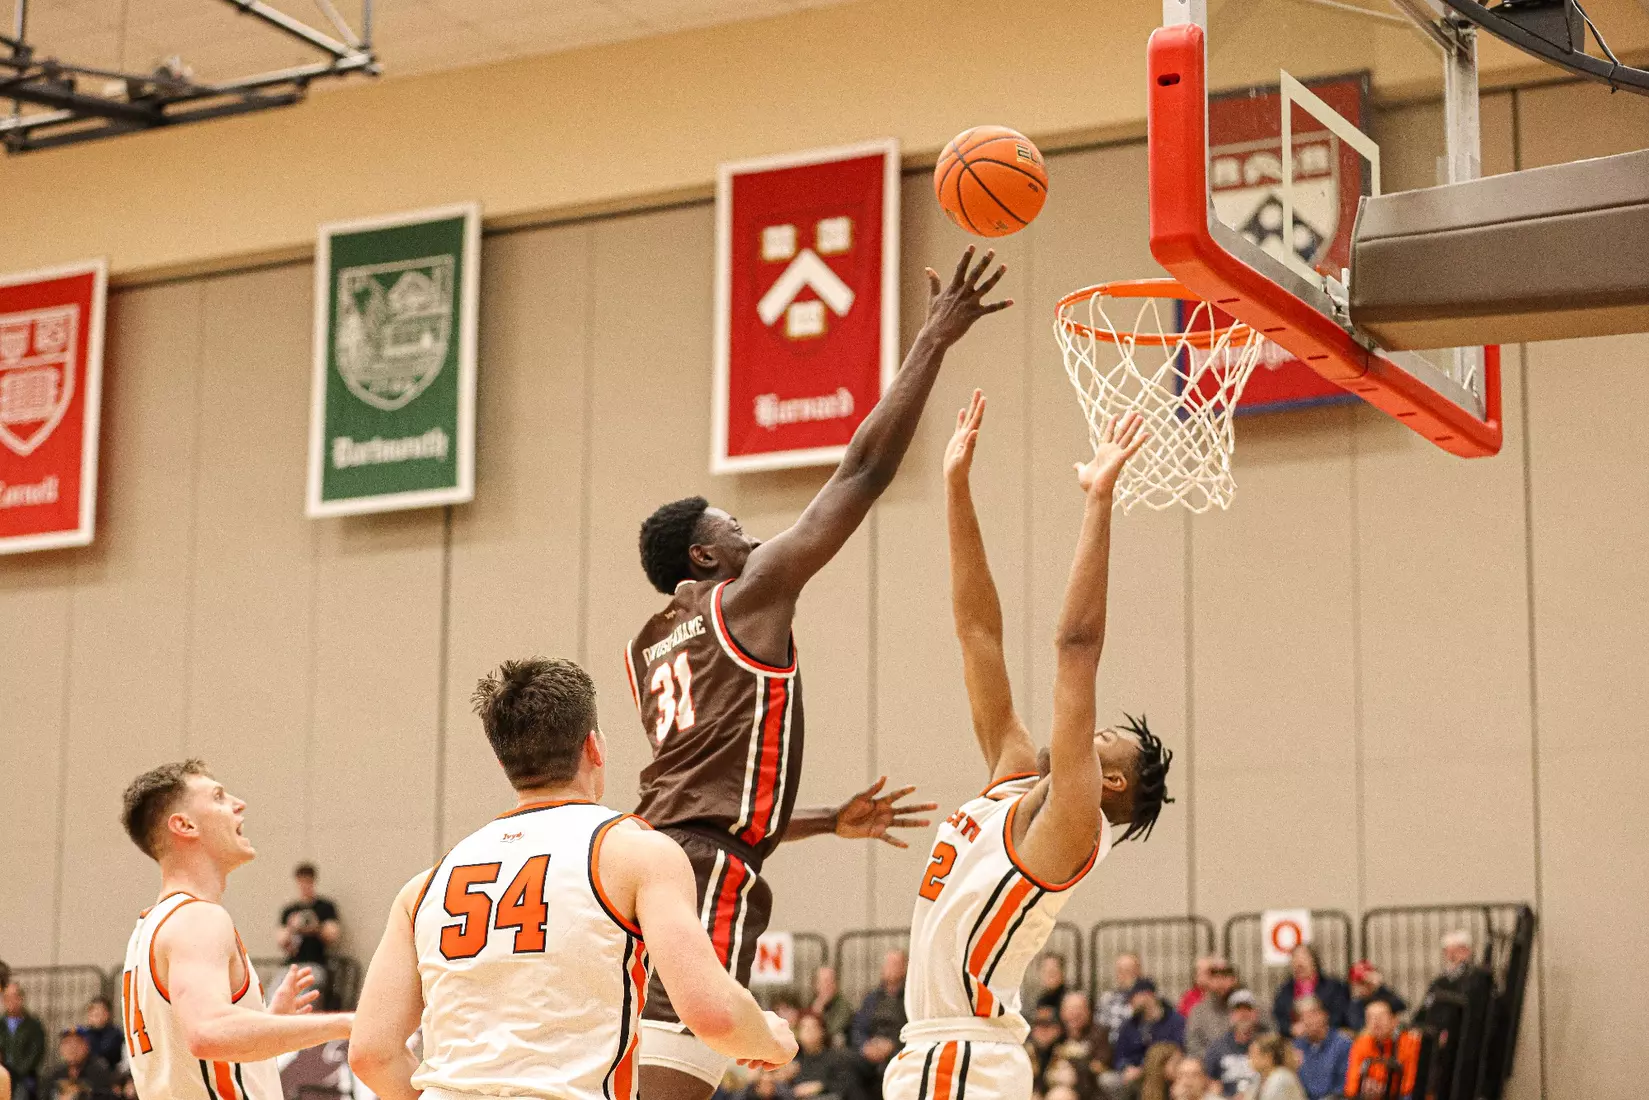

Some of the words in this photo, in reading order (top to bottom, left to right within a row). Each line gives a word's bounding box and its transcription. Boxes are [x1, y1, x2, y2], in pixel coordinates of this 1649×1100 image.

[651, 649, 696, 744] 31
[439, 854, 551, 961] 54
[919, 841, 957, 902] 2
[759, 943, 783, 973] N
[1272, 920, 1301, 954] O
[123, 964, 153, 1057] 14
